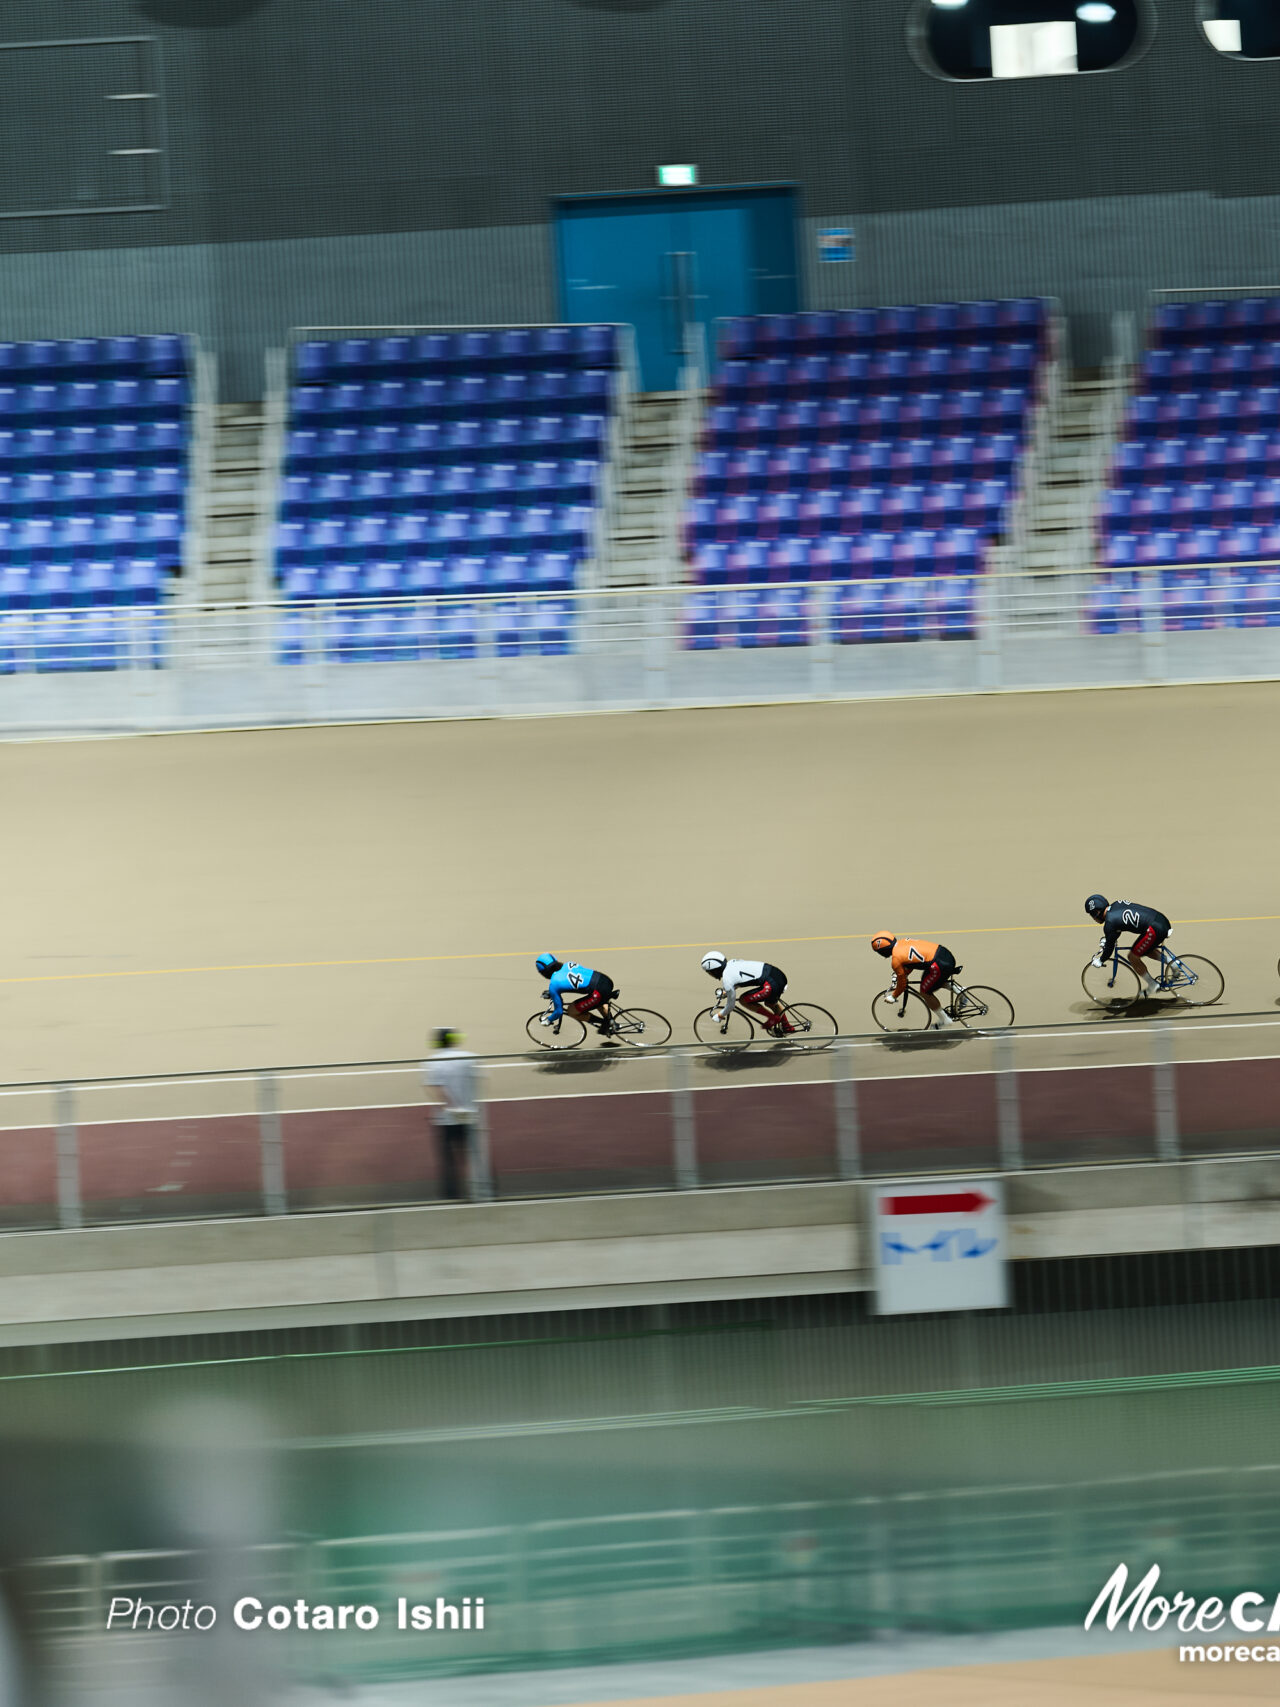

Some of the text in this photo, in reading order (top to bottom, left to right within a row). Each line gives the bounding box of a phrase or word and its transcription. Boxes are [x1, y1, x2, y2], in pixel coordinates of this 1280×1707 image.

[1123, 909, 1140, 928] 2
[908, 947, 925, 962] 7
[567, 972, 583, 989] 4
[739, 971, 755, 979] 1
